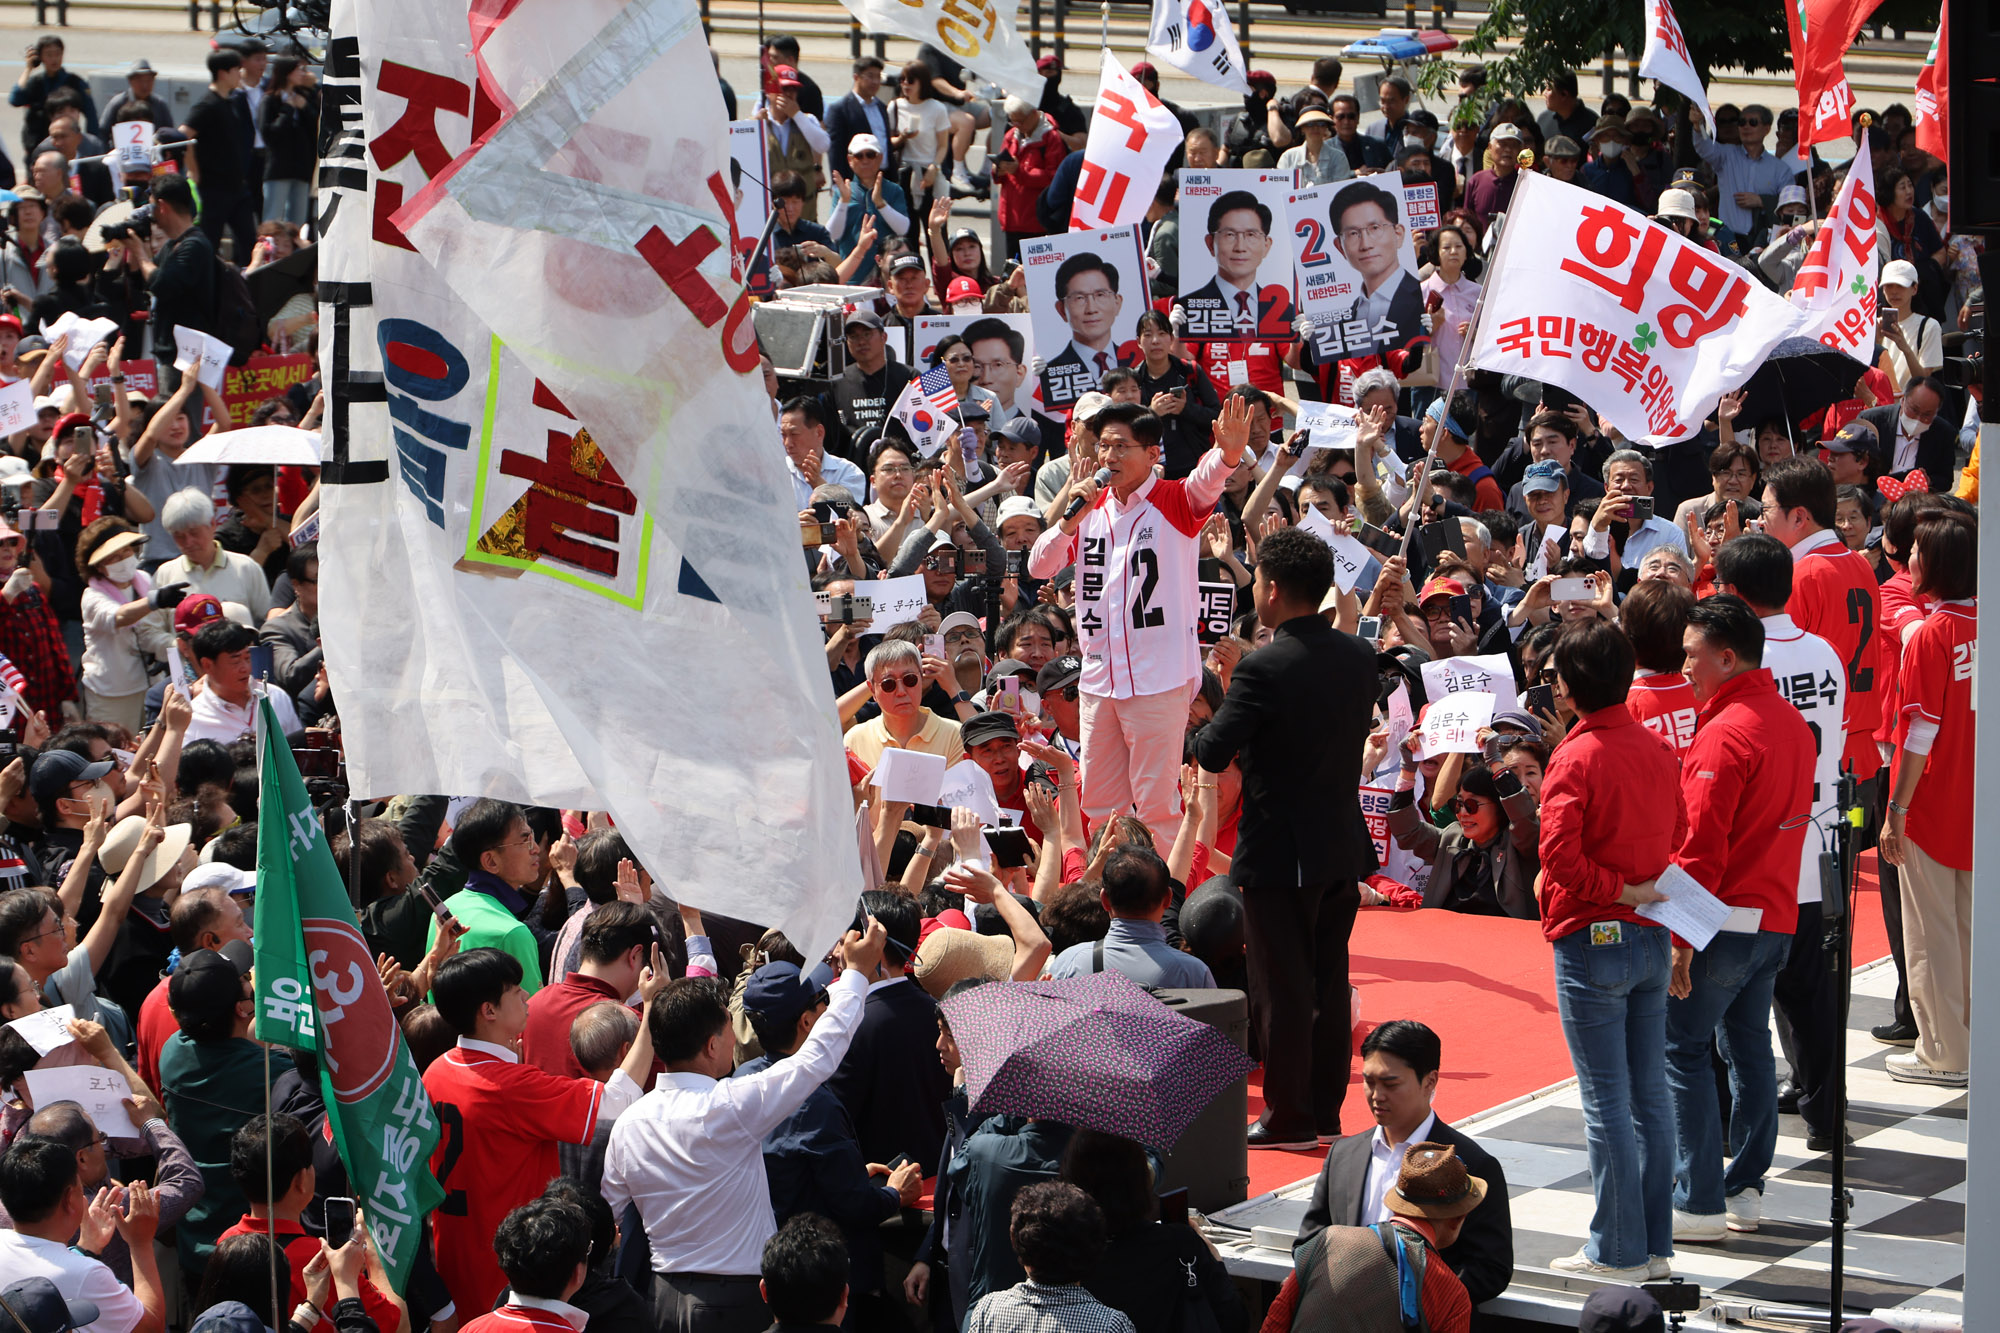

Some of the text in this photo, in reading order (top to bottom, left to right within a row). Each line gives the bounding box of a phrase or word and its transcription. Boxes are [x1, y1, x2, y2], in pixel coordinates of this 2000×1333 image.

[129, 123, 144, 144] 2
[1185, 186, 1222, 196] 대한민국!
[1403, 187, 1434, 201] 통령은
[1409, 215, 1436, 227] 김문수
[1295, 218, 1332, 268] 2
[1028, 252, 1066, 266] 대한민국!
[1560, 204, 1752, 350] 희망
[1307, 283, 1352, 301] 대한민국!
[1187, 283, 1291, 335] 김문수 2
[1315, 315, 1400, 357] 김문수
[852, 397, 886, 408] UNDER
[1081, 537, 1106, 637] 김문수
[1131, 547, 1165, 630] 2
[1847, 587, 1874, 693] 2
[1445, 671, 1492, 693] 김문수
[1430, 711, 1469, 730] 김문수
[1359, 793, 1389, 814] 령은
